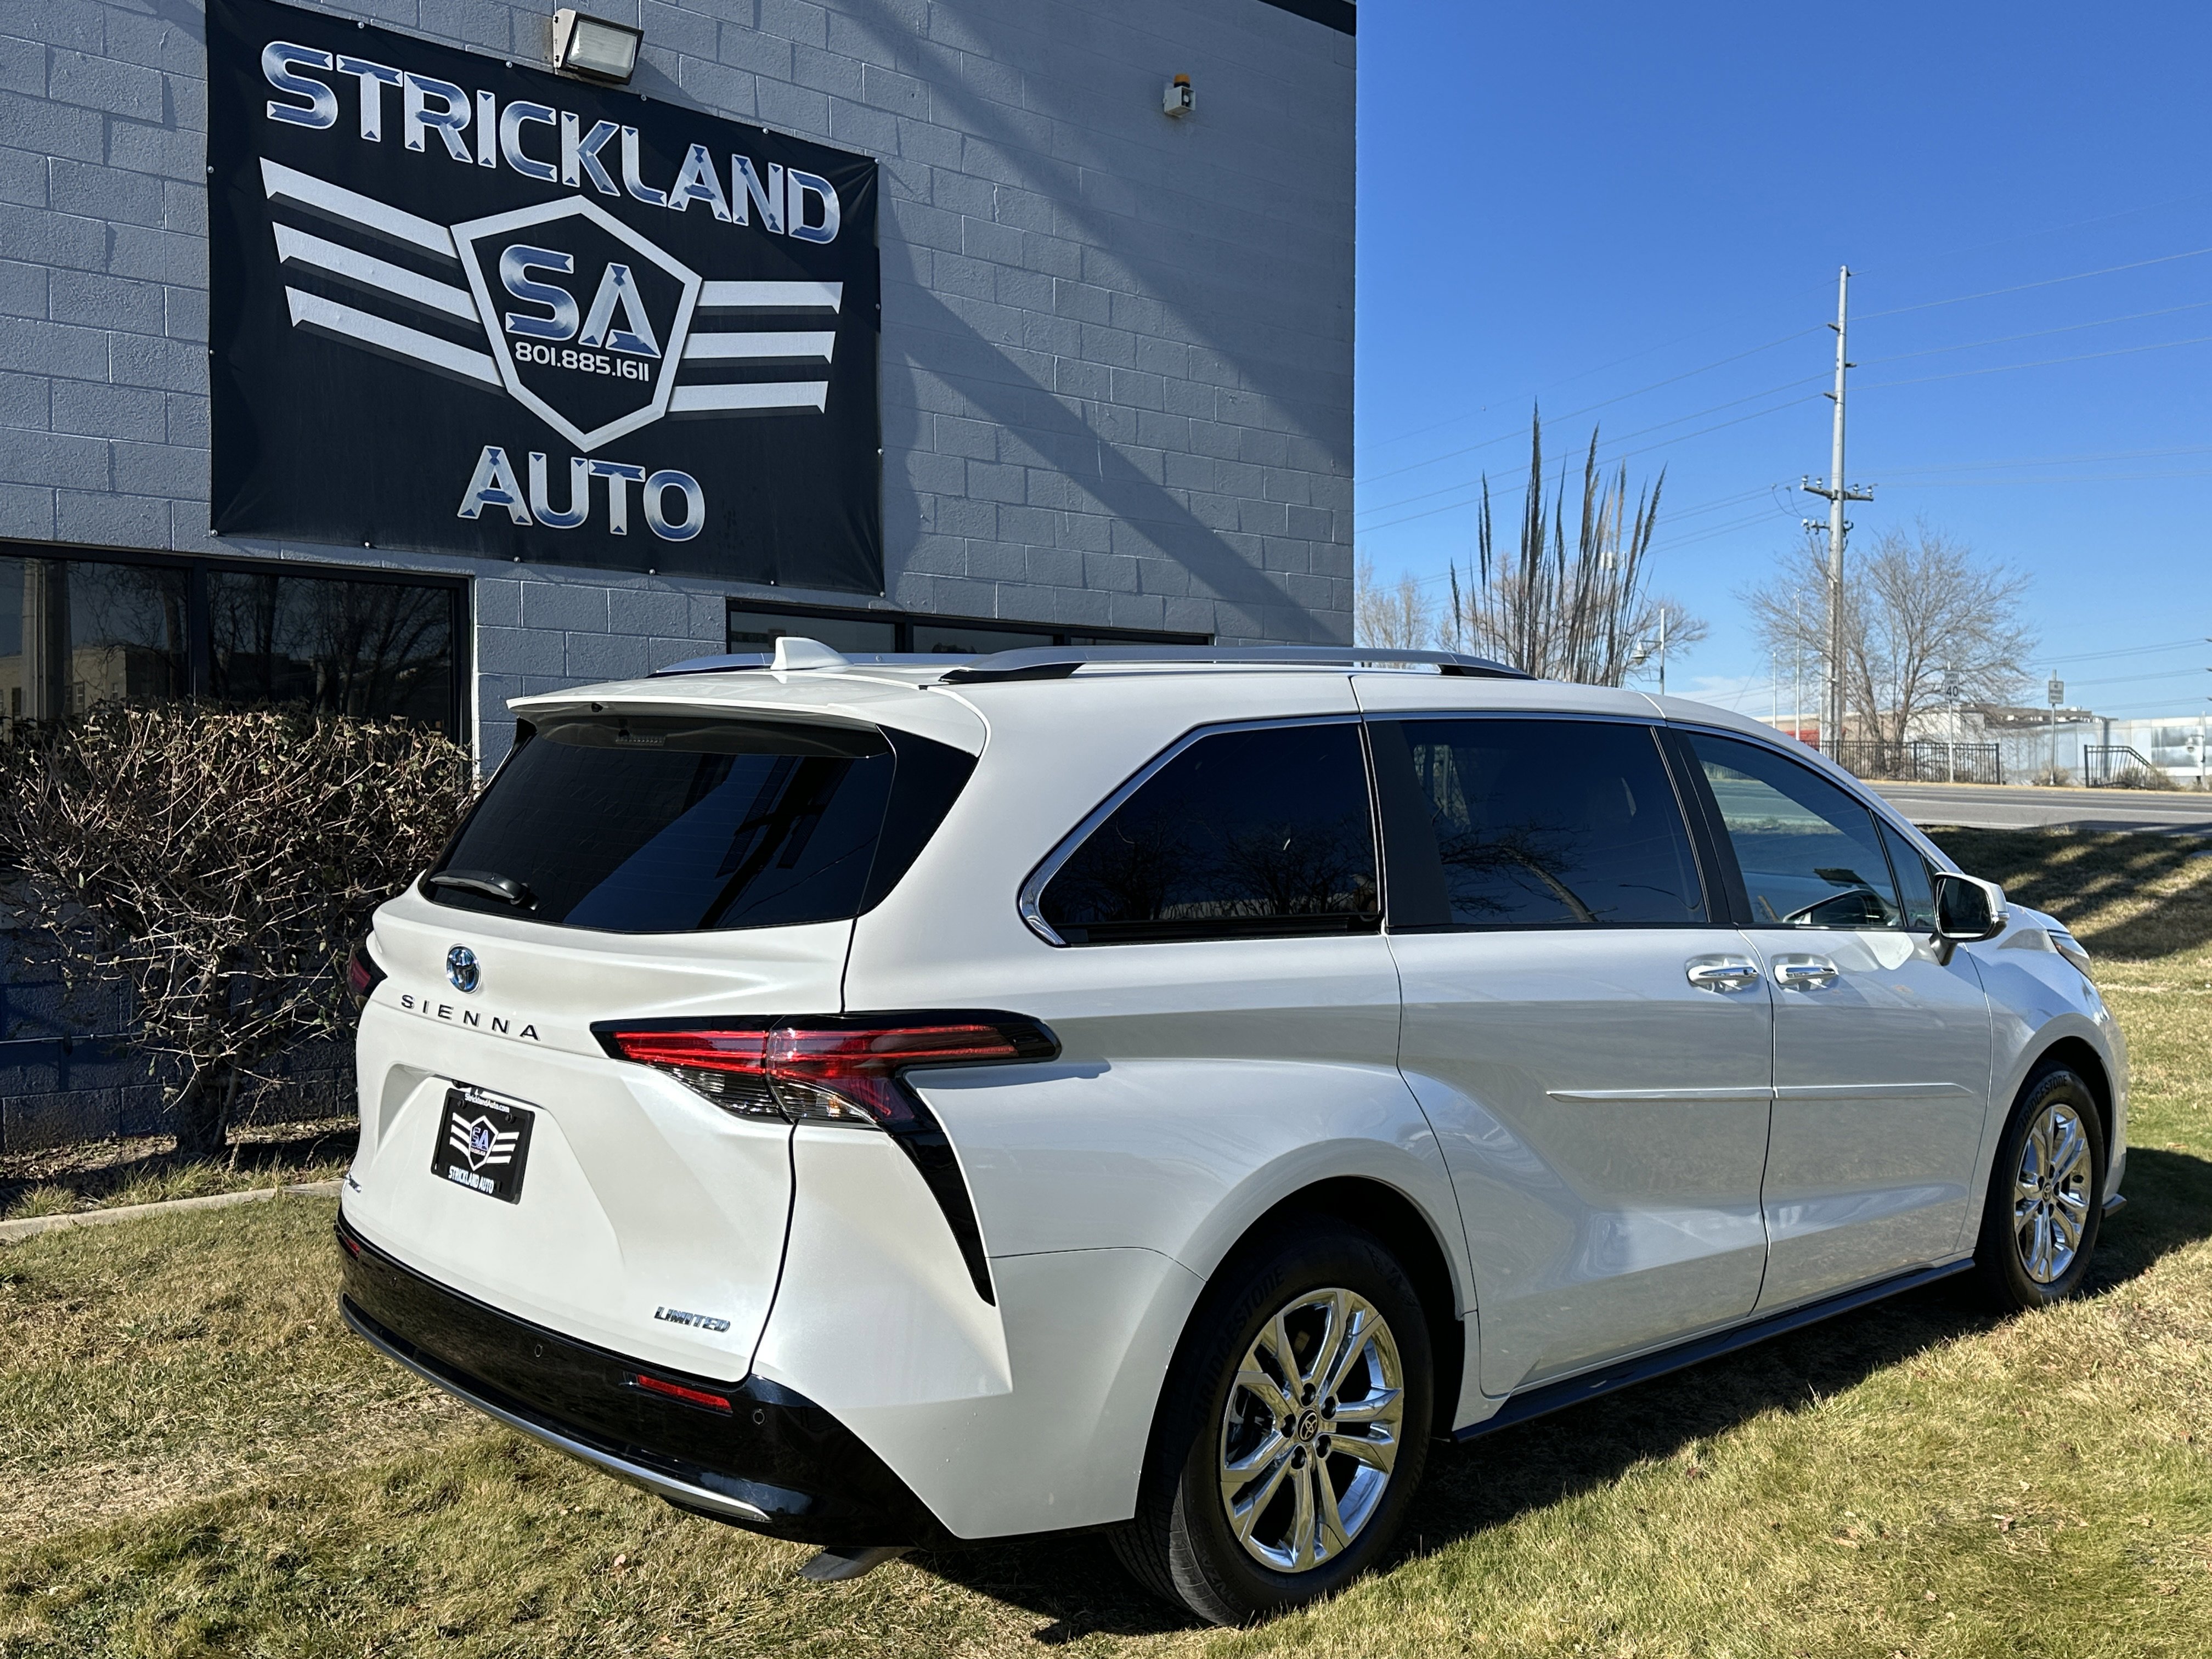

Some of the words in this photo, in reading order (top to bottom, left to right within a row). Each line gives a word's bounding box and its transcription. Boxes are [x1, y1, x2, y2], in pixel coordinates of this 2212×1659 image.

[261, 41, 841, 244] STRICKLAND
[499, 244, 662, 358] SA
[515, 341, 649, 382] 801.885.1611
[457, 445, 706, 542] AUTO
[1946, 686, 1959, 697] 40
[401, 995, 540, 1041] SIENNA
[471, 1126, 489, 1151] SA
[448, 1165, 480, 1189] STRICKLAND
[478, 1176, 494, 1194] AUTO
[654, 1306, 731, 1333] LIMITED
